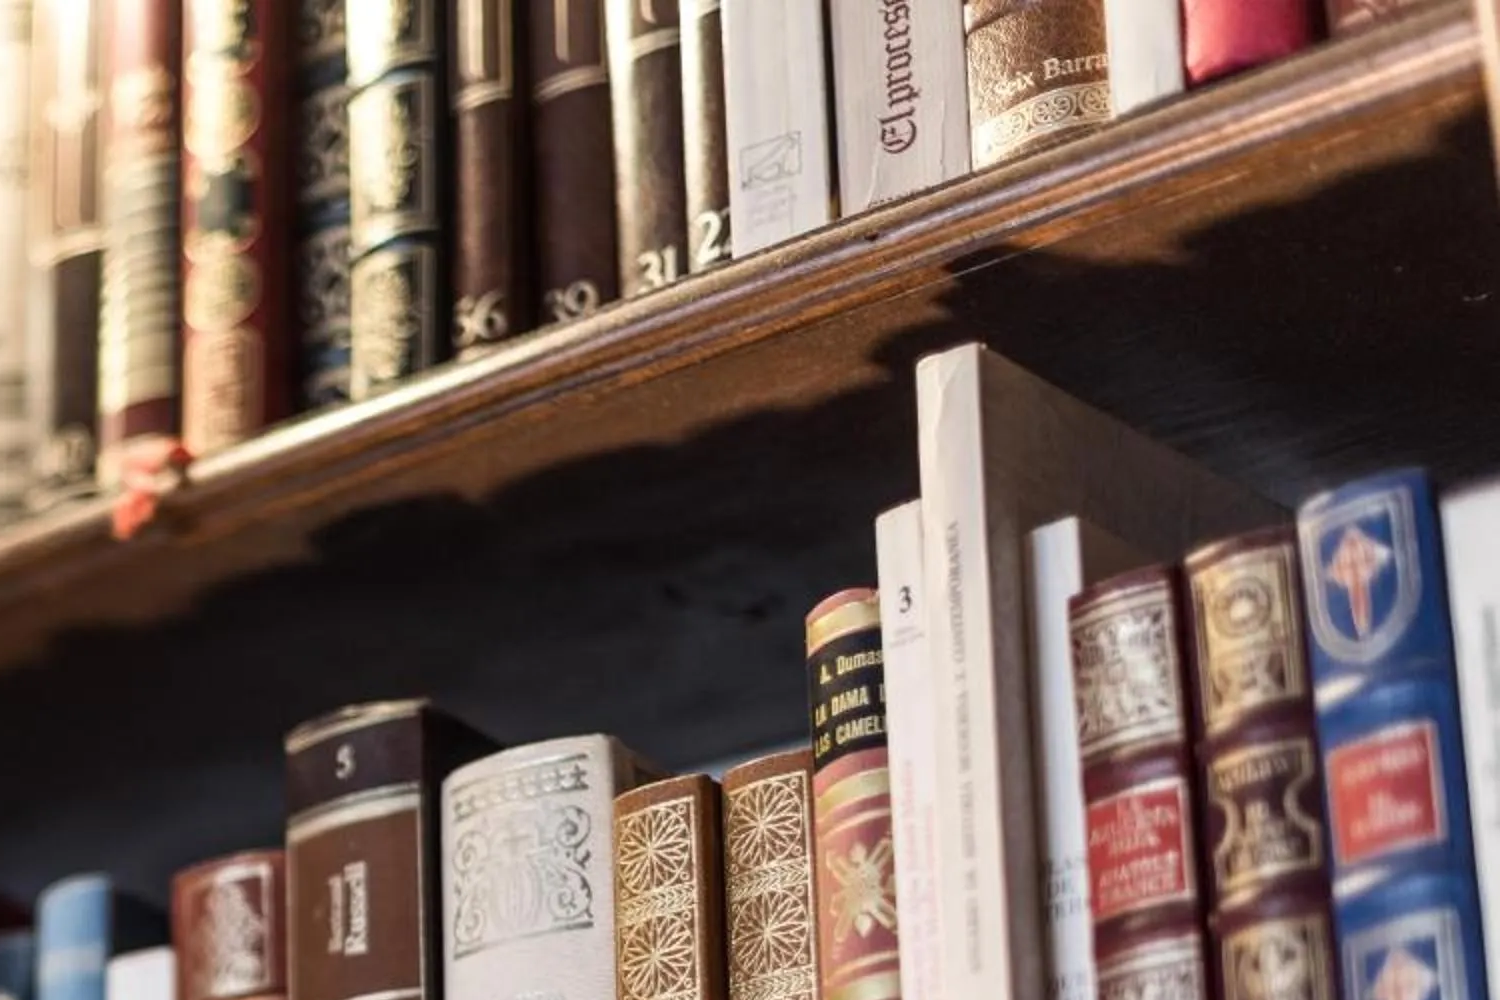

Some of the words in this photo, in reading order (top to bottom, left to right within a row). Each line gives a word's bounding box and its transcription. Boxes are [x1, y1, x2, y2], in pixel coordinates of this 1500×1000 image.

[899, 586, 912, 613] 3
[836, 650, 884, 675] Dumas
[815, 703, 827, 727] LA
[831, 685, 870, 715] DAMA
[815, 732, 831, 758] LAS
[344, 860, 368, 956] Russell
